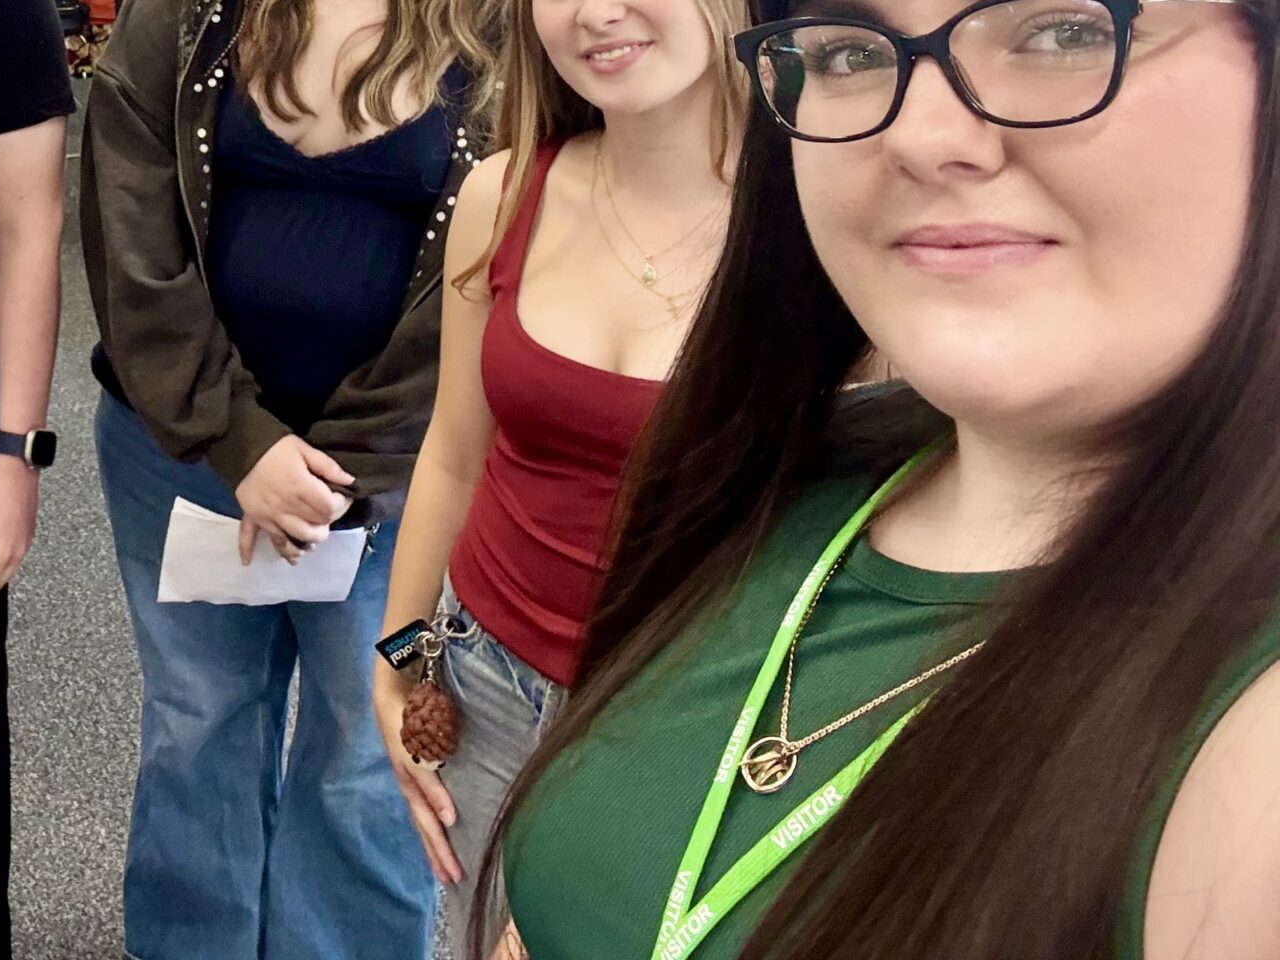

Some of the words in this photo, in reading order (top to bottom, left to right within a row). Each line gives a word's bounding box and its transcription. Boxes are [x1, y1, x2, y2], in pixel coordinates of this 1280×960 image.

[390, 642, 415, 666] otal
[713, 707, 753, 784] VISITOR
[770, 785, 842, 850] VISITOR
[656, 870, 692, 950] VISITO
